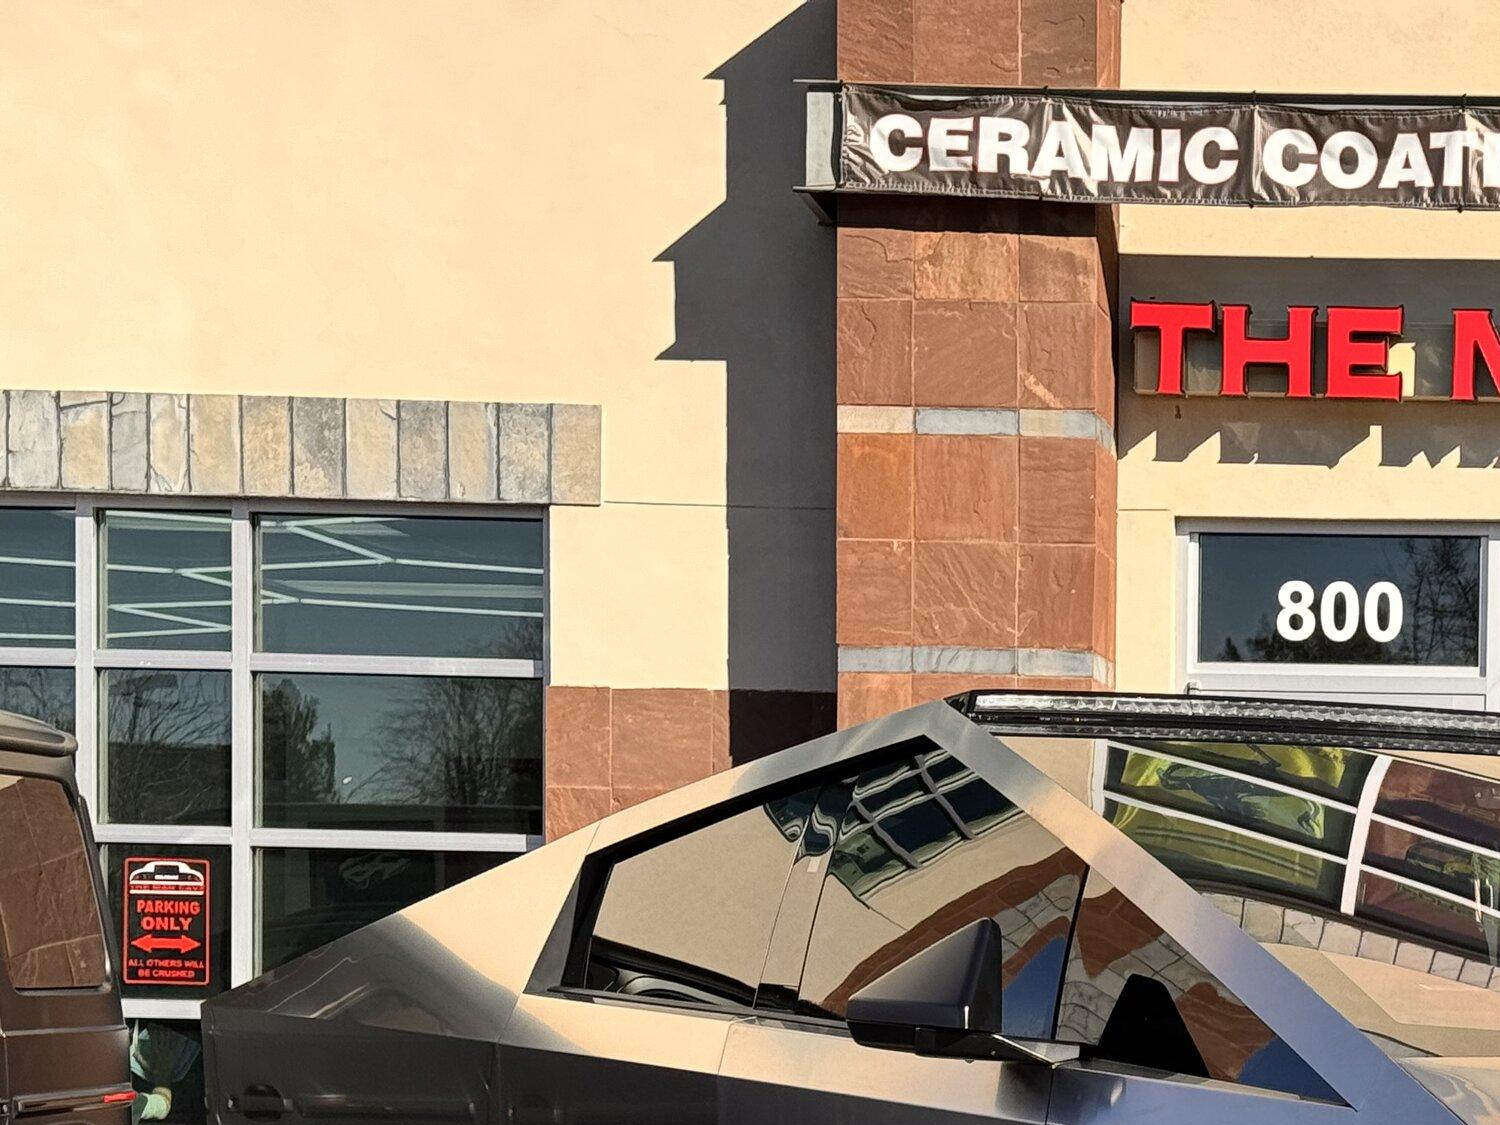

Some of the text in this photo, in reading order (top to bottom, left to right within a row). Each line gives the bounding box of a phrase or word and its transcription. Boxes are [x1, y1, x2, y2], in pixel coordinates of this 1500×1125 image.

[867, 113, 1240, 187] CERAMIC
[1129, 300, 1404, 400] THE
[1276, 580, 1404, 642] 800
[137, 900, 200, 914] PARKING
[141, 917, 192, 930] ONLY
[128, 959, 204, 969] ALL OTHERS WILL
[138, 968, 196, 979] BE CRUSHED
